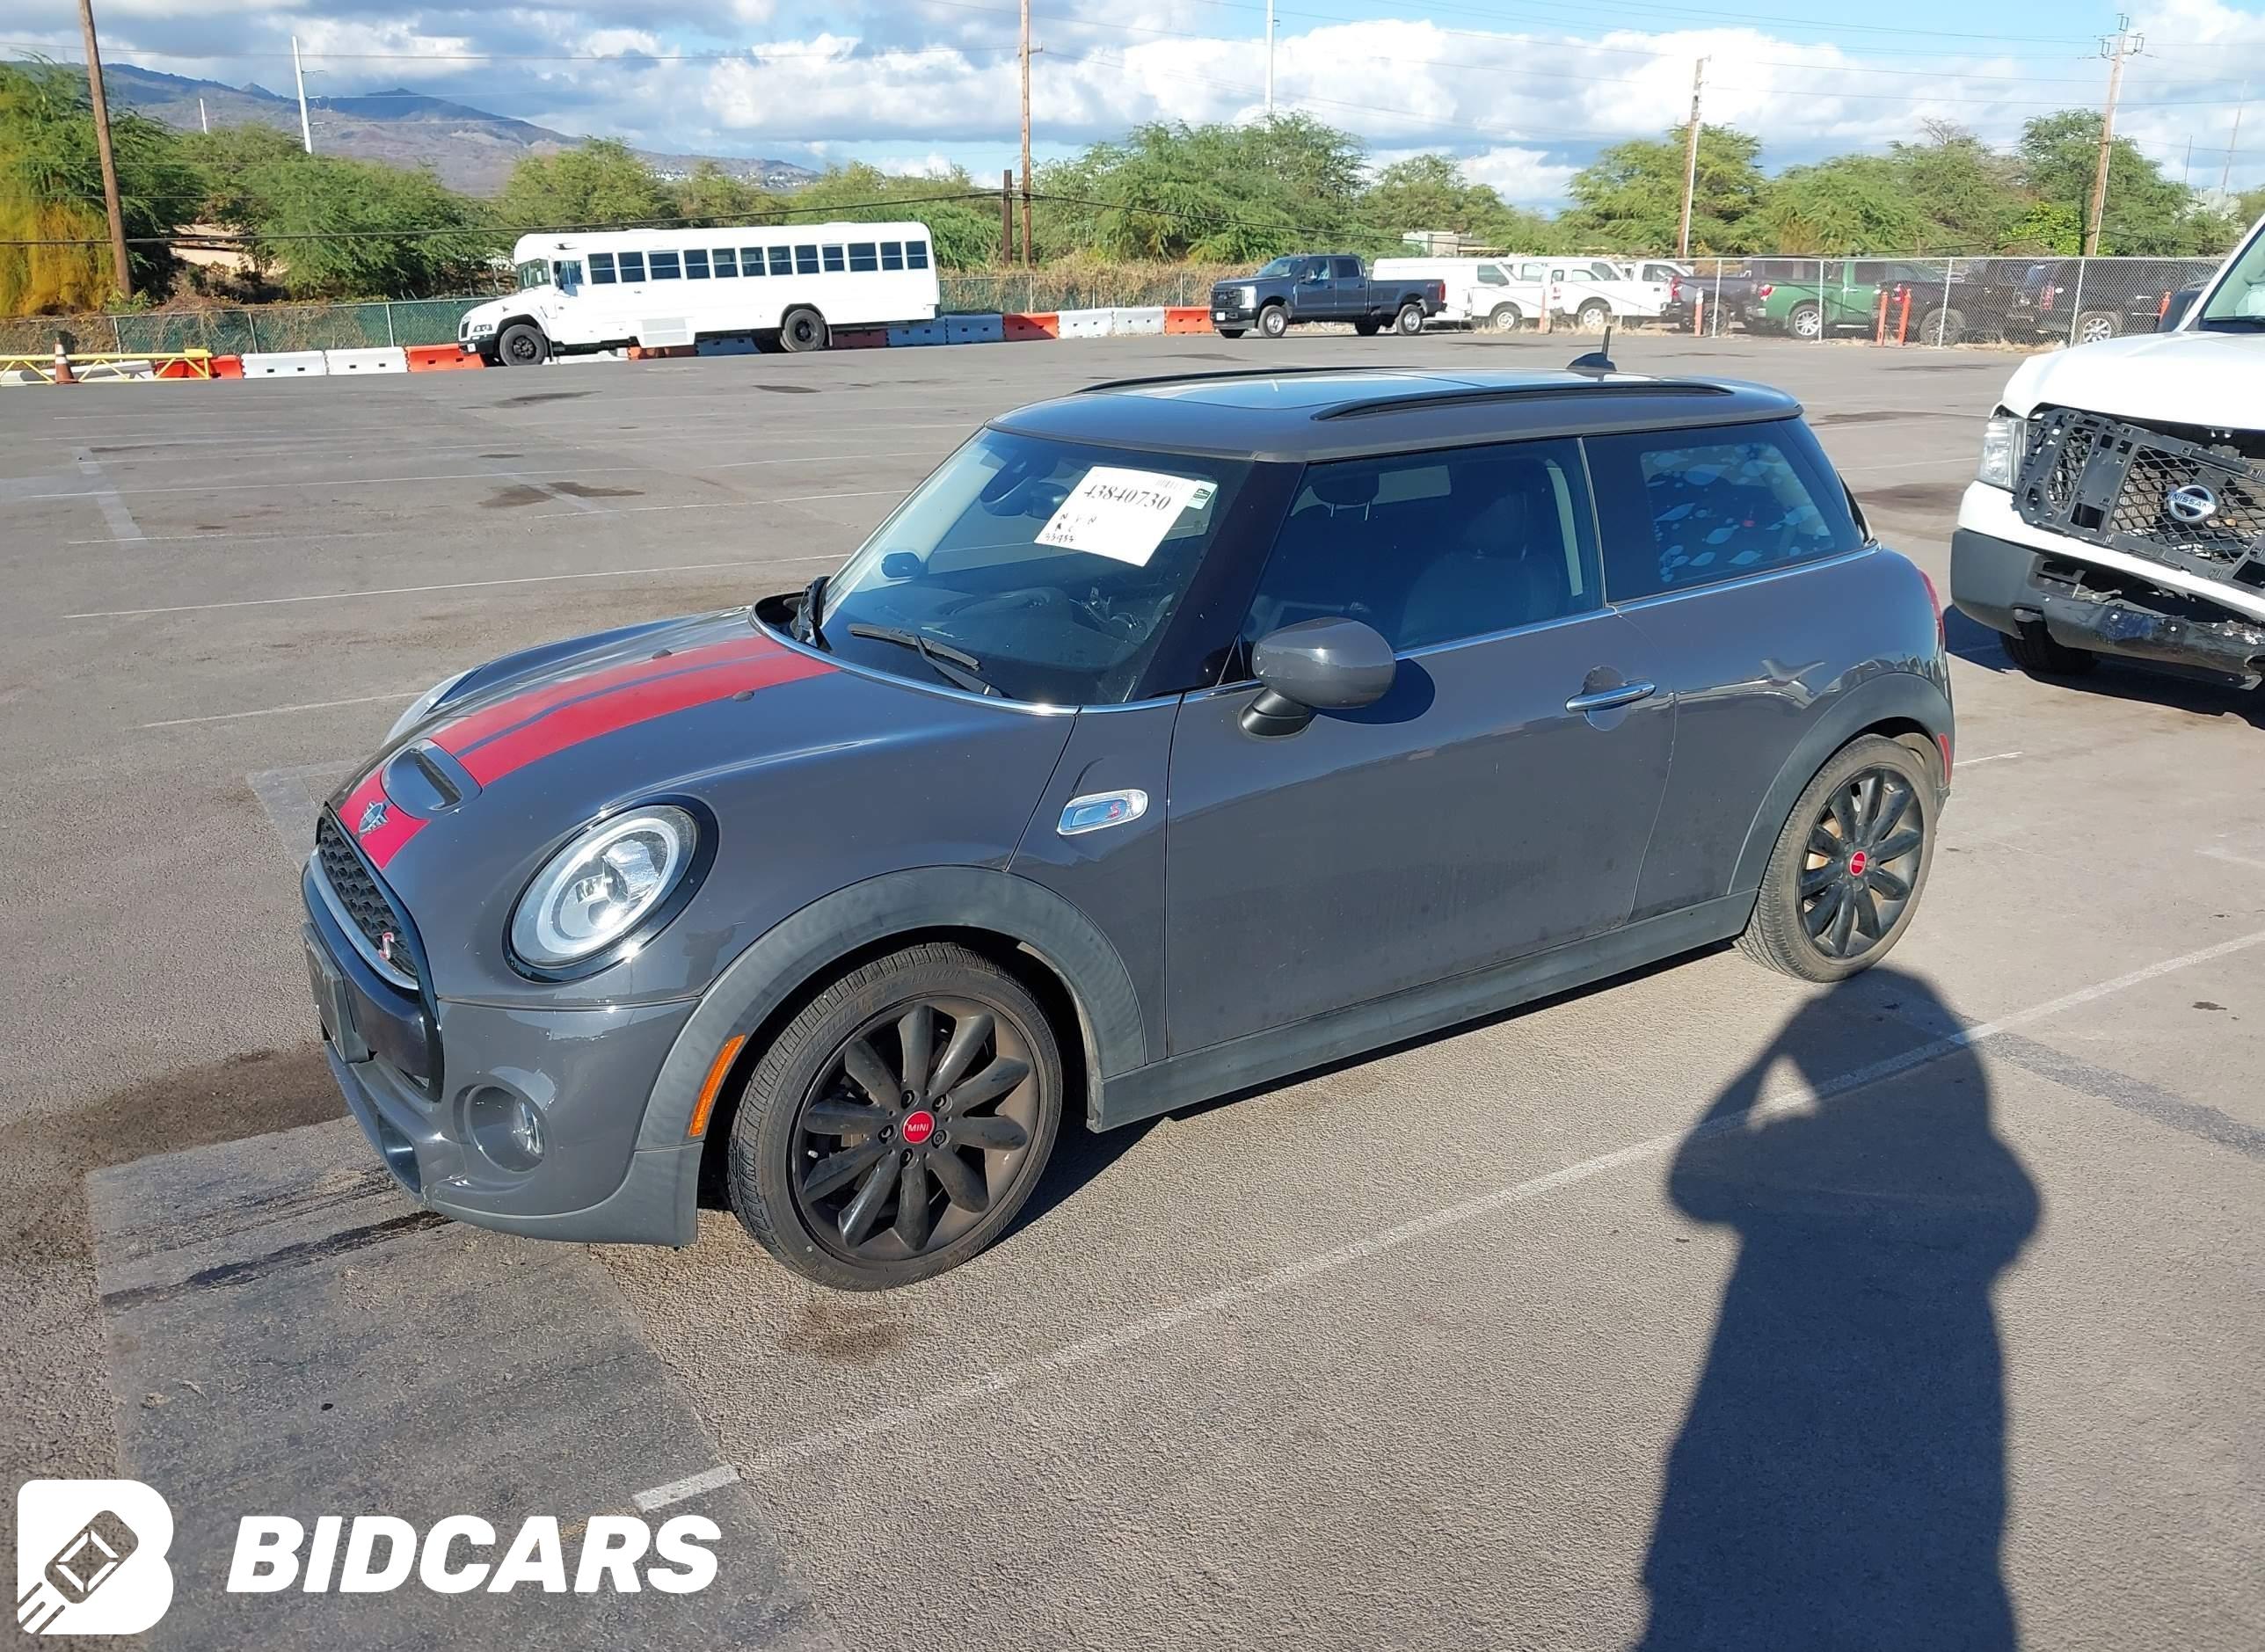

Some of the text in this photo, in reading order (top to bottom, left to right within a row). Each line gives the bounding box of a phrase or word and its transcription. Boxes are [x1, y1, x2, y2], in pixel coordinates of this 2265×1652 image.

[1084, 484, 1172, 512] 43840730
[2173, 492, 2212, 509] NISSA
[907, 1123, 929, 1132] MINI
